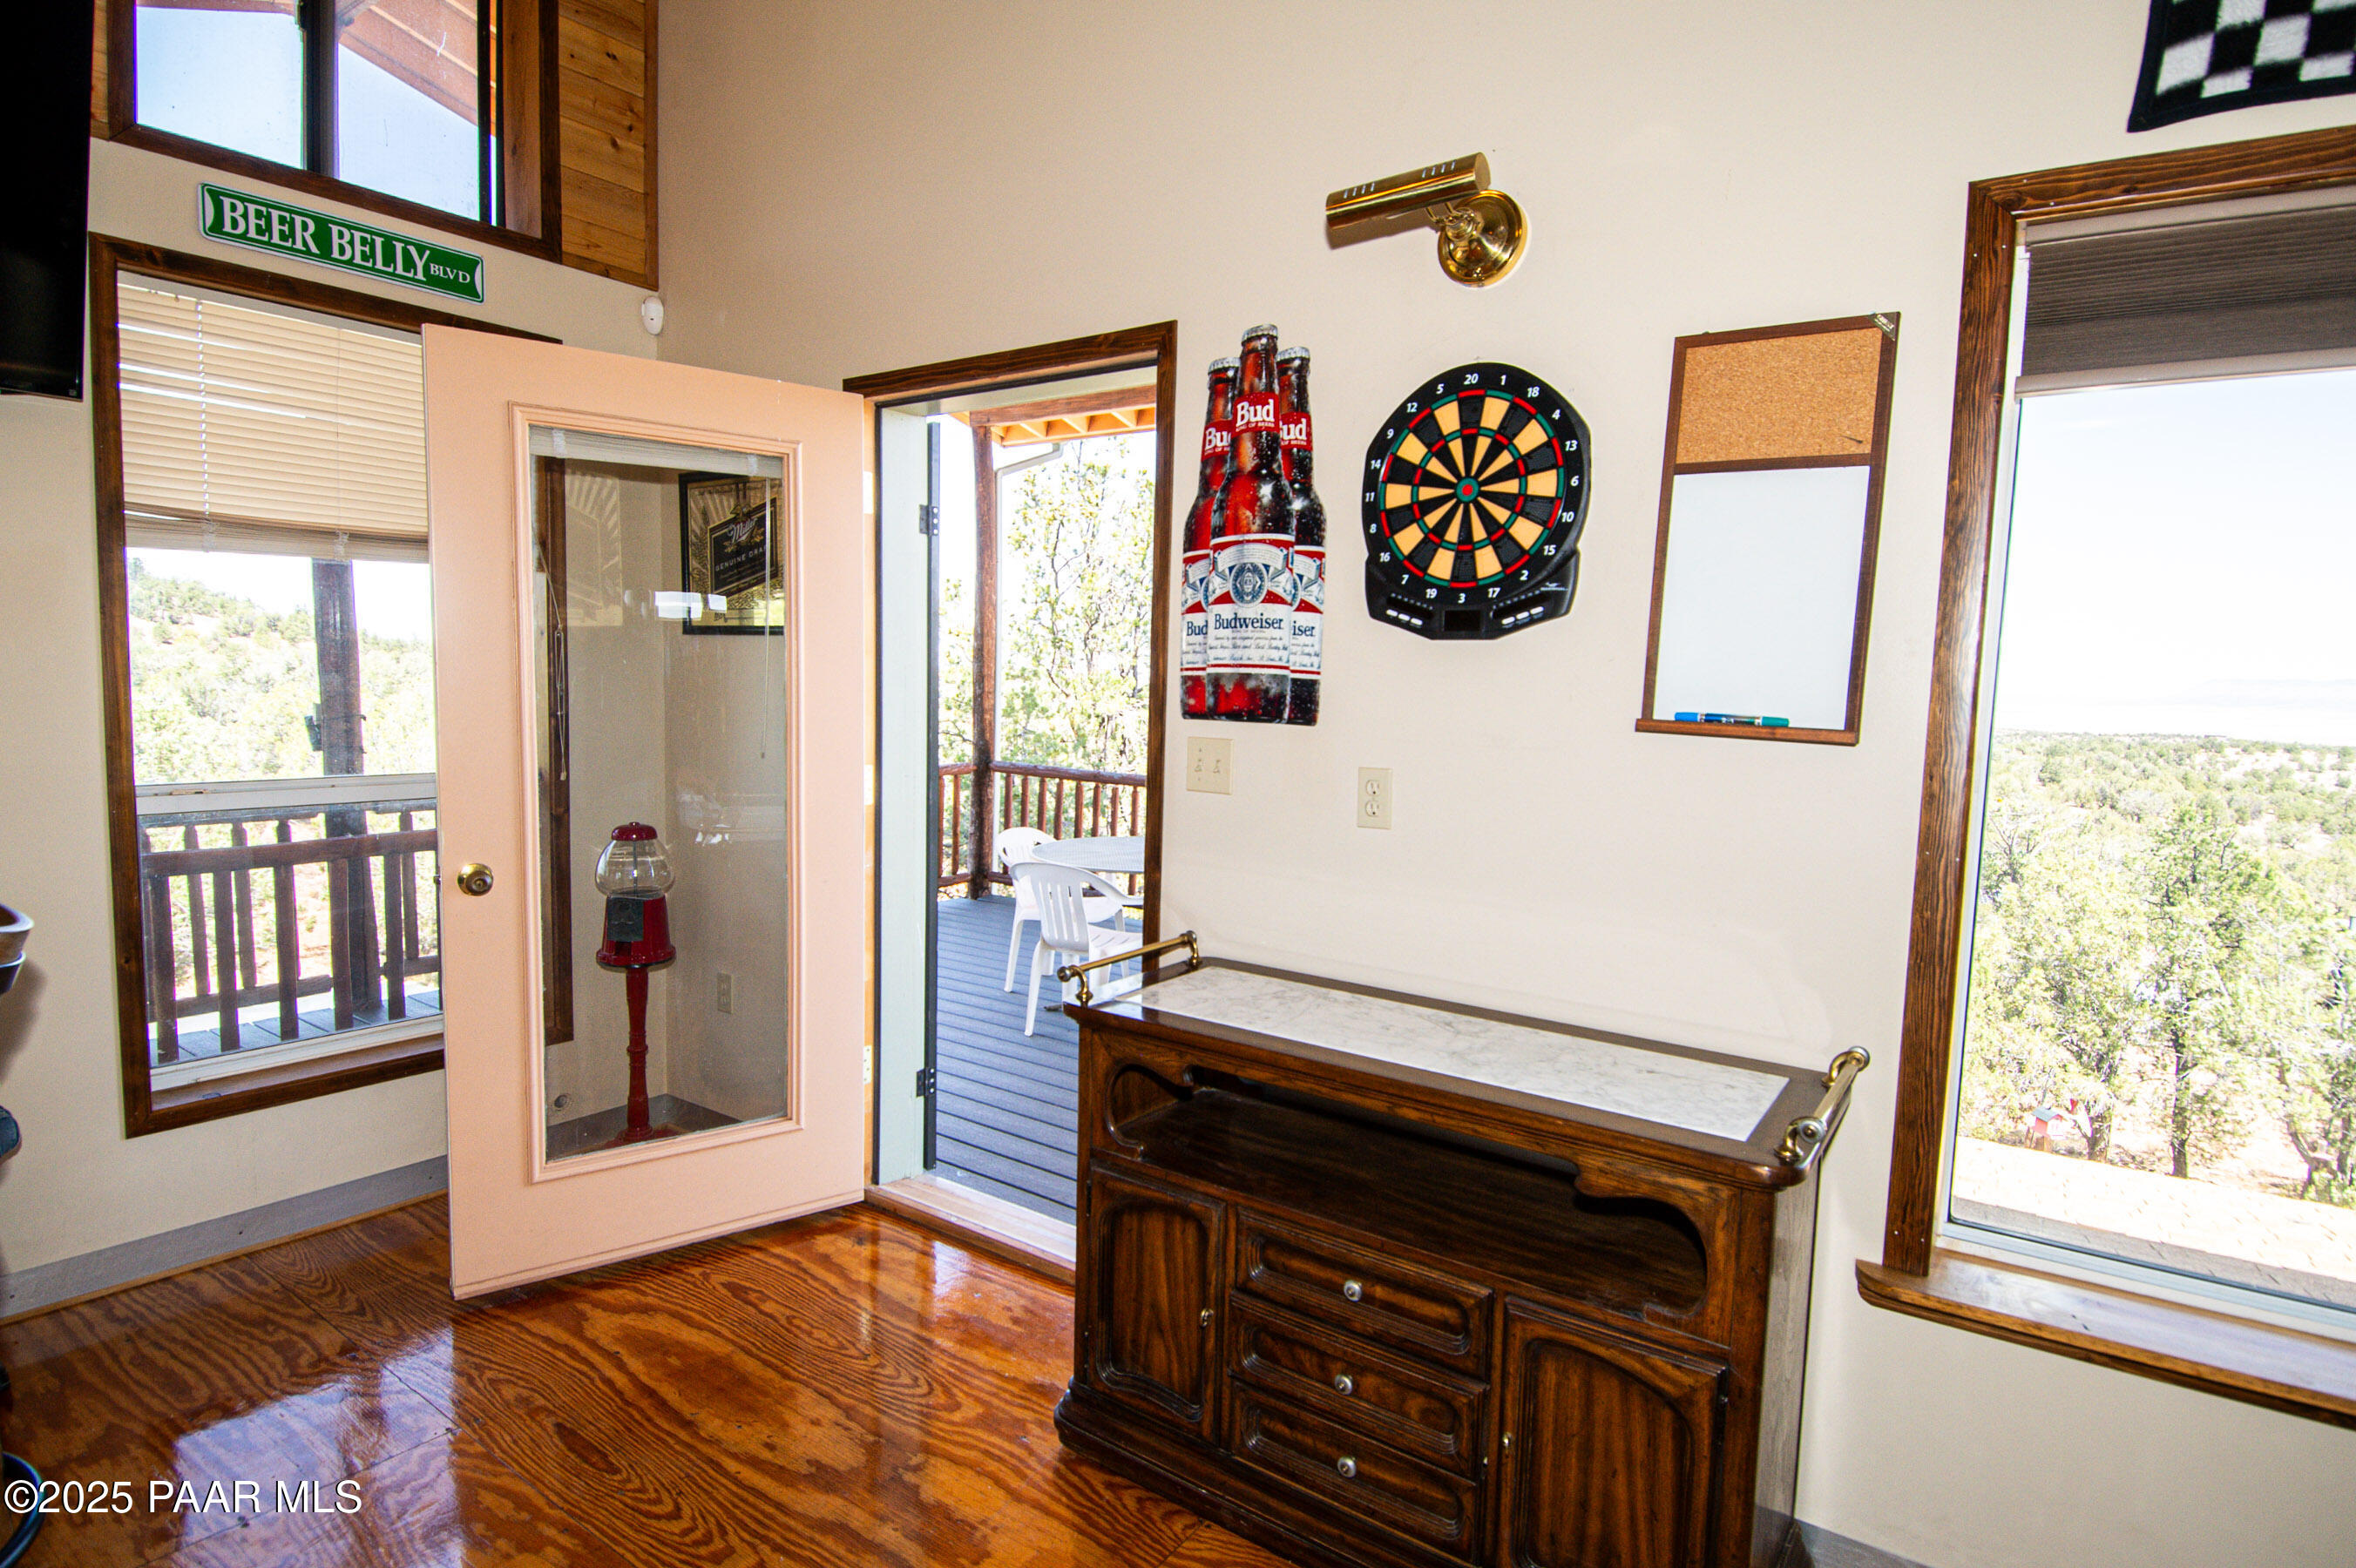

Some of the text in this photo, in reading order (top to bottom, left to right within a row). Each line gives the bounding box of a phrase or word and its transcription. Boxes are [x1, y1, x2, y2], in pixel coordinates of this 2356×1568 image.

[219, 195, 471, 284] BEER BELLY BLVD
[1463, 373, 1479, 385] 20
[1500, 375, 1507, 386] 1
[1436, 383, 1445, 395] 5
[1527, 387, 1540, 398] 18
[1236, 398, 1275, 427] Bud
[1405, 402, 1418, 413] 12
[1551, 409, 1561, 420] 4
[1280, 418, 1307, 441] ud
[1386, 429, 1395, 439] 9
[1204, 428, 1231, 450] Bu
[1564, 440, 1578, 451] 13
[1370, 459, 1382, 470] 14
[1570, 476, 1580, 486] 6
[1364, 491, 1376, 503] 11
[1561, 510, 1575, 523] 10
[1369, 524, 1378, 534] 8
[1542, 544, 1557, 556] 15
[715, 553, 746, 571] GENUINE
[1379, 551, 1391, 563] 16
[1400, 575, 1410, 585] 7
[1519, 570, 1529, 581] 2
[1425, 588, 1438, 599] 19
[1487, 587, 1502, 598] 17
[1458, 593, 1466, 604] 3
[1214, 612, 1284, 630] Budweiser
